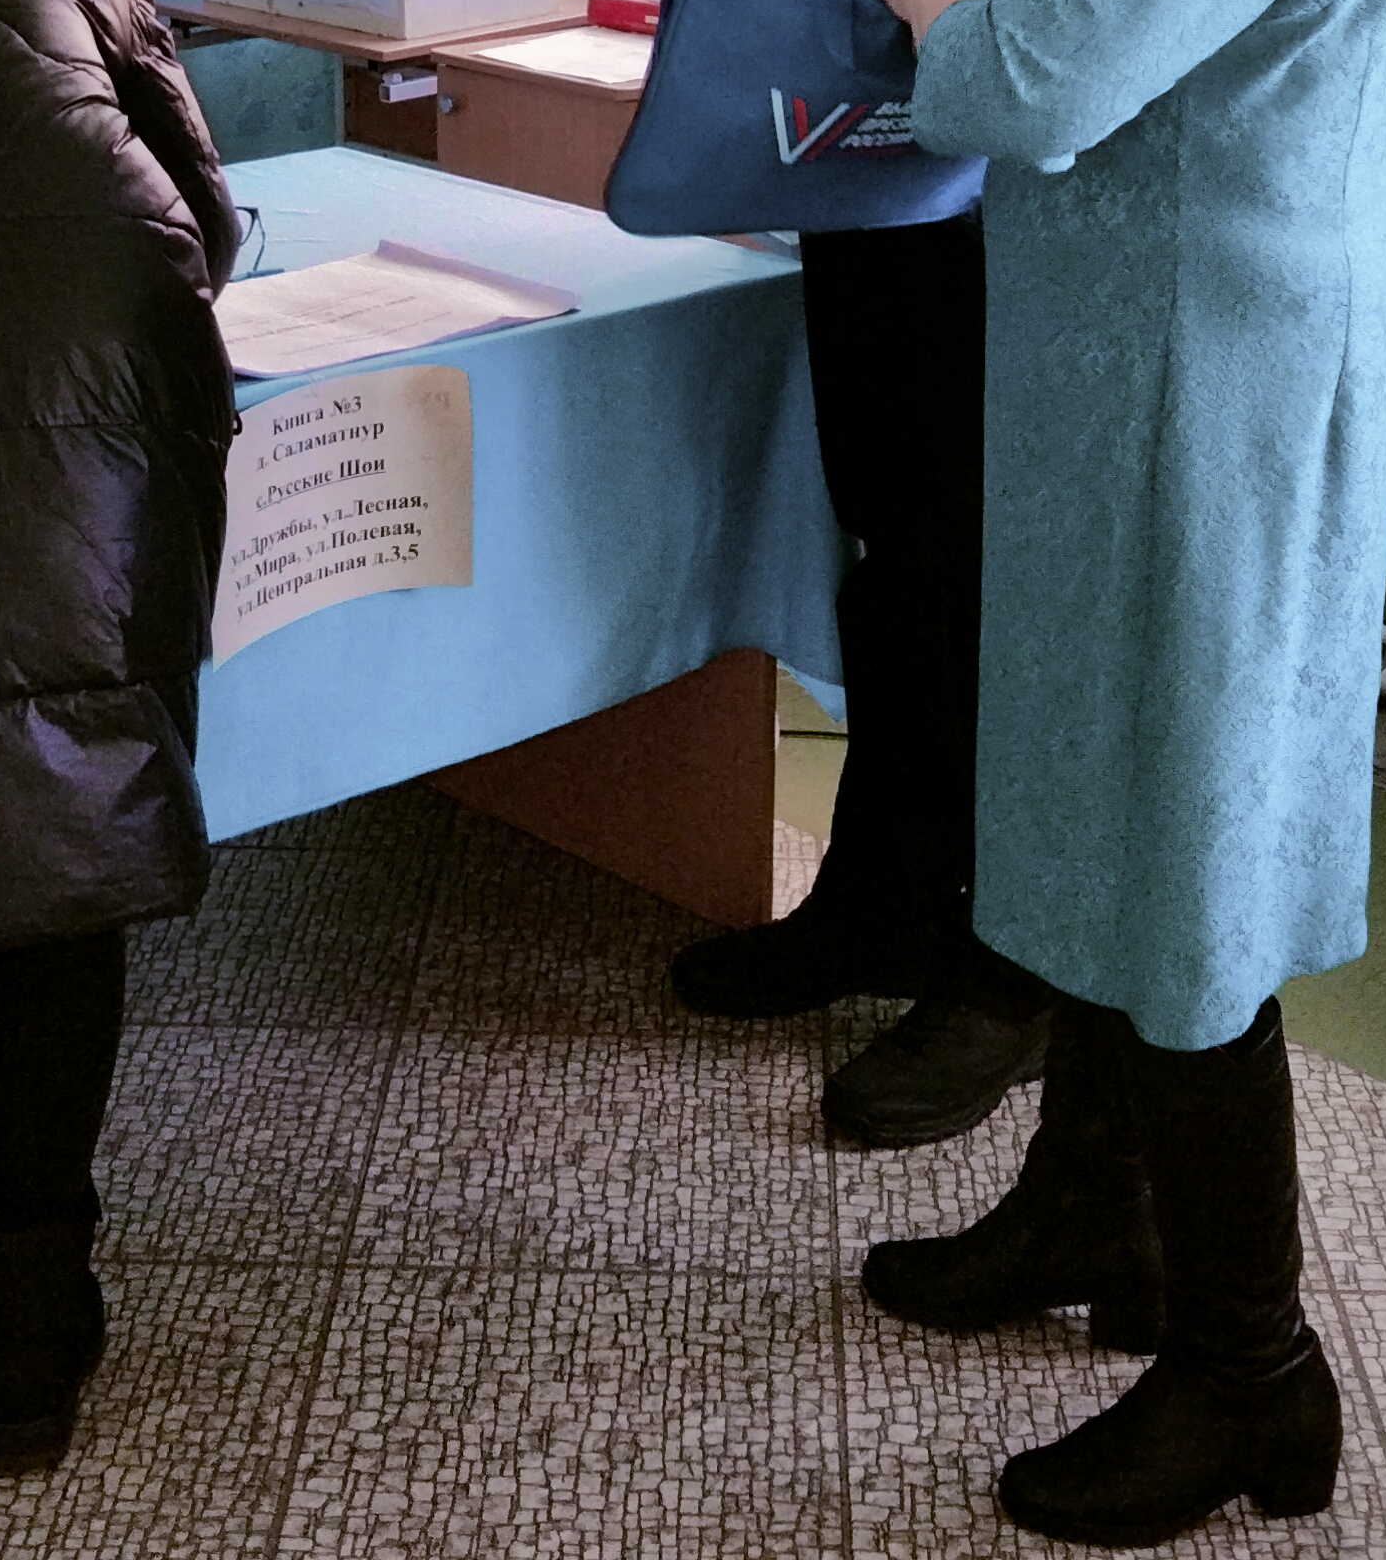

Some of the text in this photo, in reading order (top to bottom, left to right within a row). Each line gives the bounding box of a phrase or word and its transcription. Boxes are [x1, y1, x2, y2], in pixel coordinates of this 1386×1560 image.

[272, 395, 363, 437] Книга №3
[272, 420, 385, 464] Саламатнур
[340, 456, 386, 479] Шои
[322, 493, 429, 529] ул.Лесная,
[306, 519, 422, 564] ул.Полевая,
[237, 542, 420, 621] ул.Центральная д.3,5
